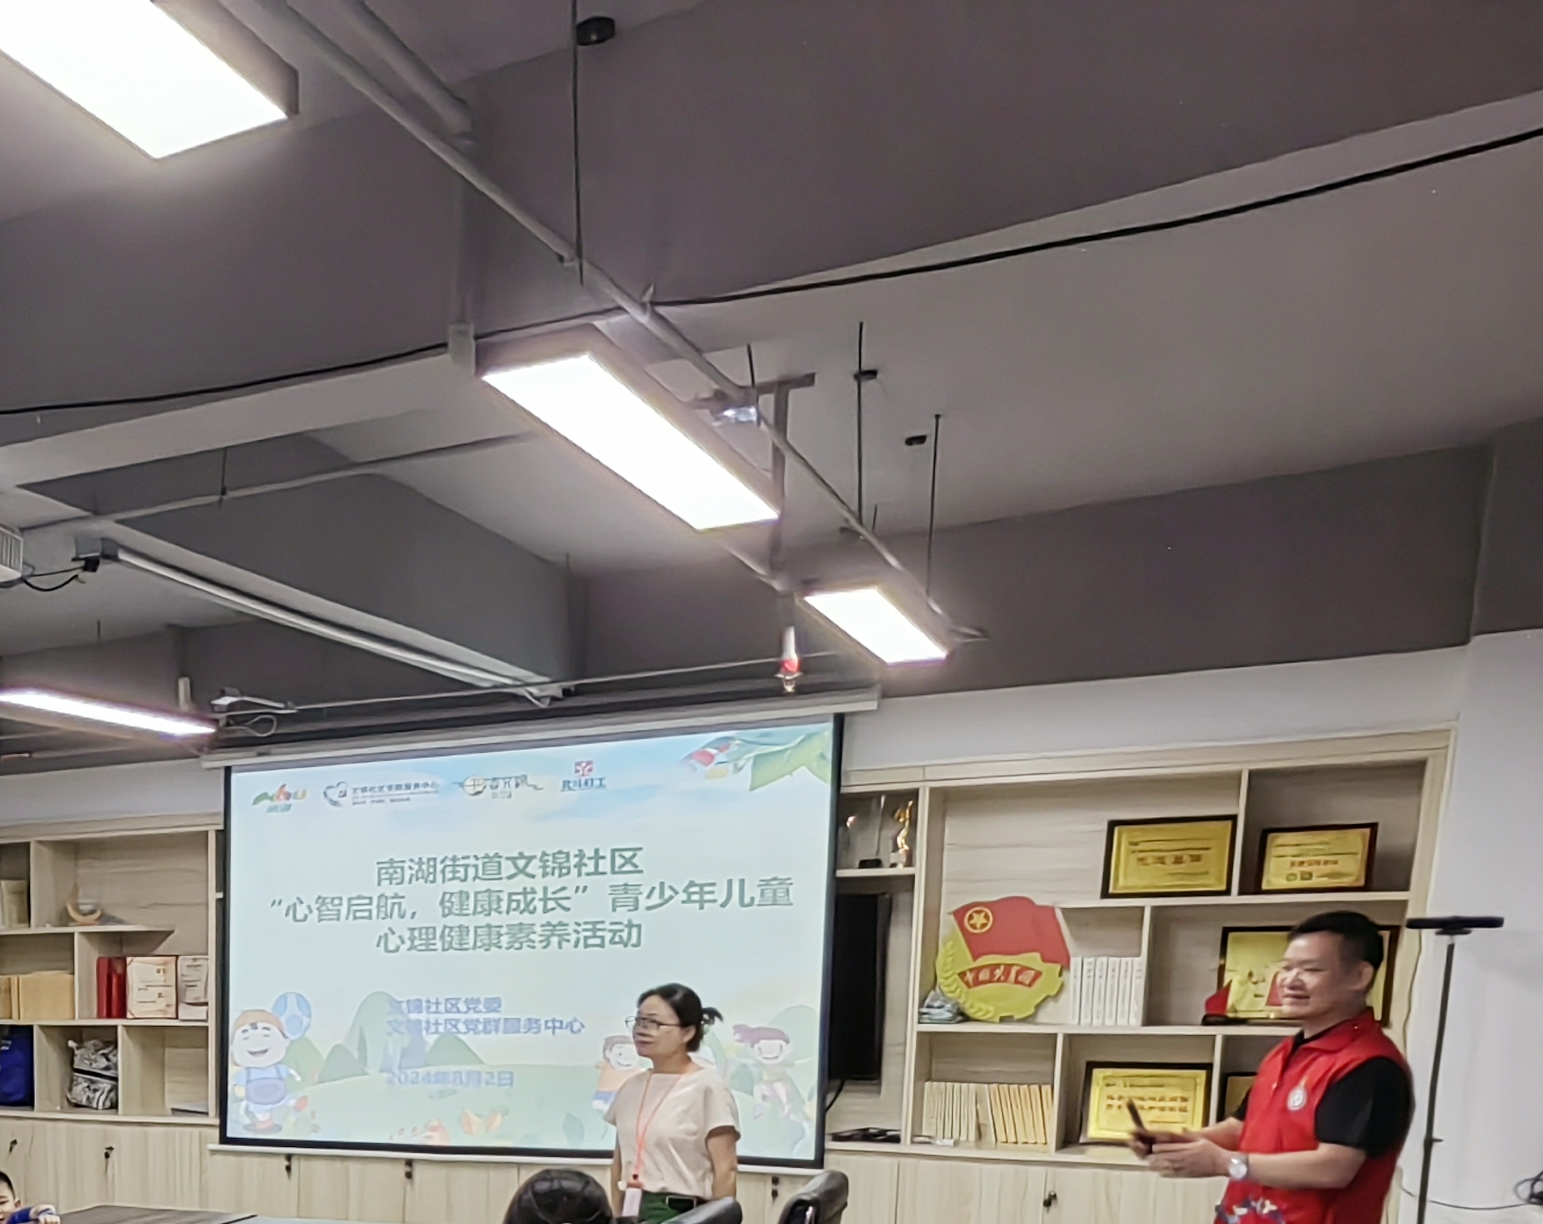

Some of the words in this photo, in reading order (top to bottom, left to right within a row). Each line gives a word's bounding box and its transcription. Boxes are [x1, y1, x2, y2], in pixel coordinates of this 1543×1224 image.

[375, 846, 644, 888] 南湖街道文锦社区
[375, 918, 643, 954] 心理健康素养活动
